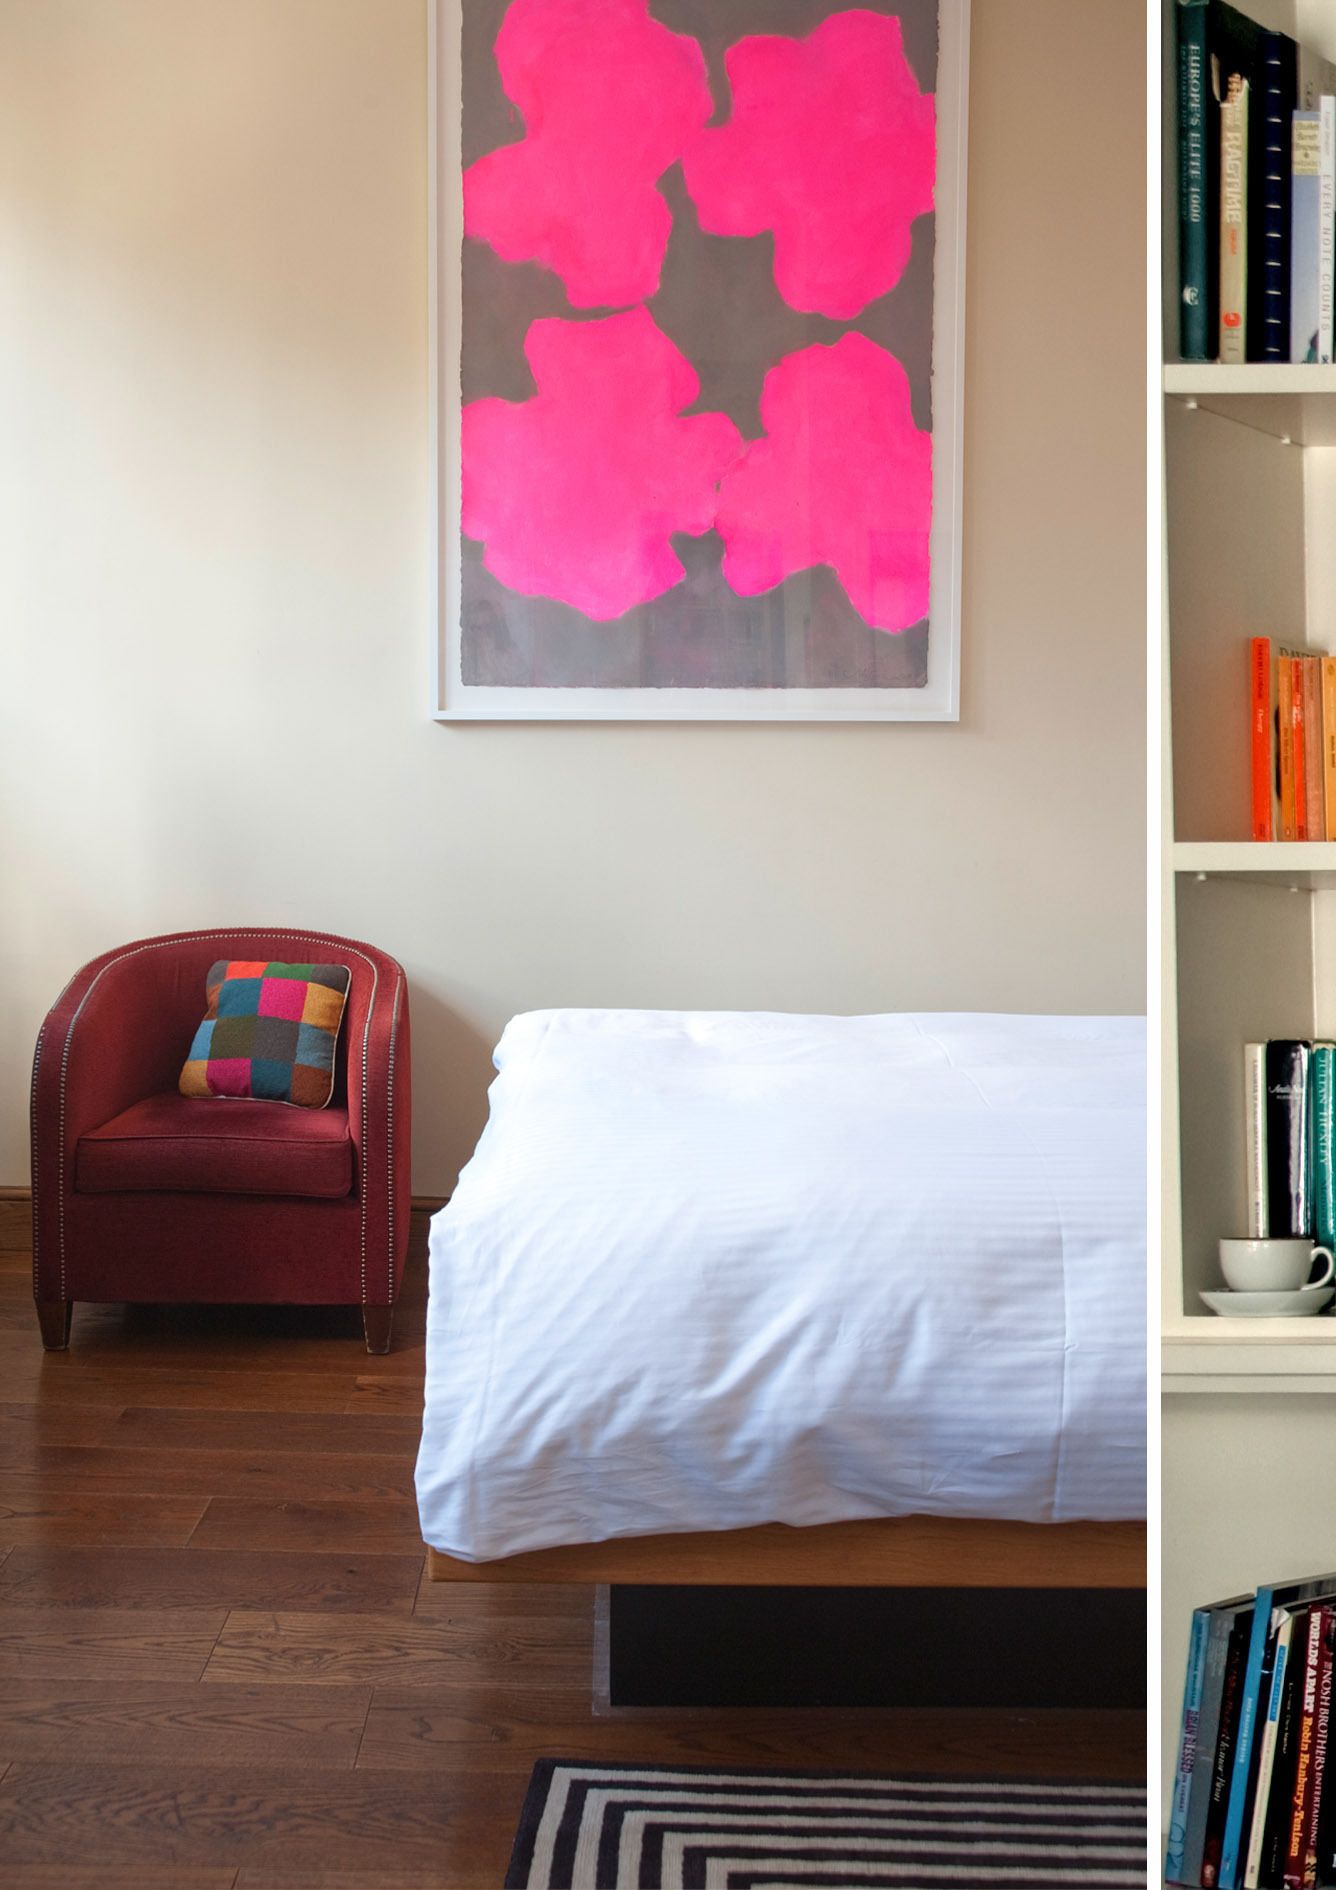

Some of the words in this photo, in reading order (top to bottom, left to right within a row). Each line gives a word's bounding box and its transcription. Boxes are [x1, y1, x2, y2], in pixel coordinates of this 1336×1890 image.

[1306, 1613, 1322, 1665] WORLDS
[1303, 1668, 1319, 1713] APART
[1302, 1716, 1312, 1750] Robin
[1291, 1754, 1312, 1856] Hanbury-Tenison
